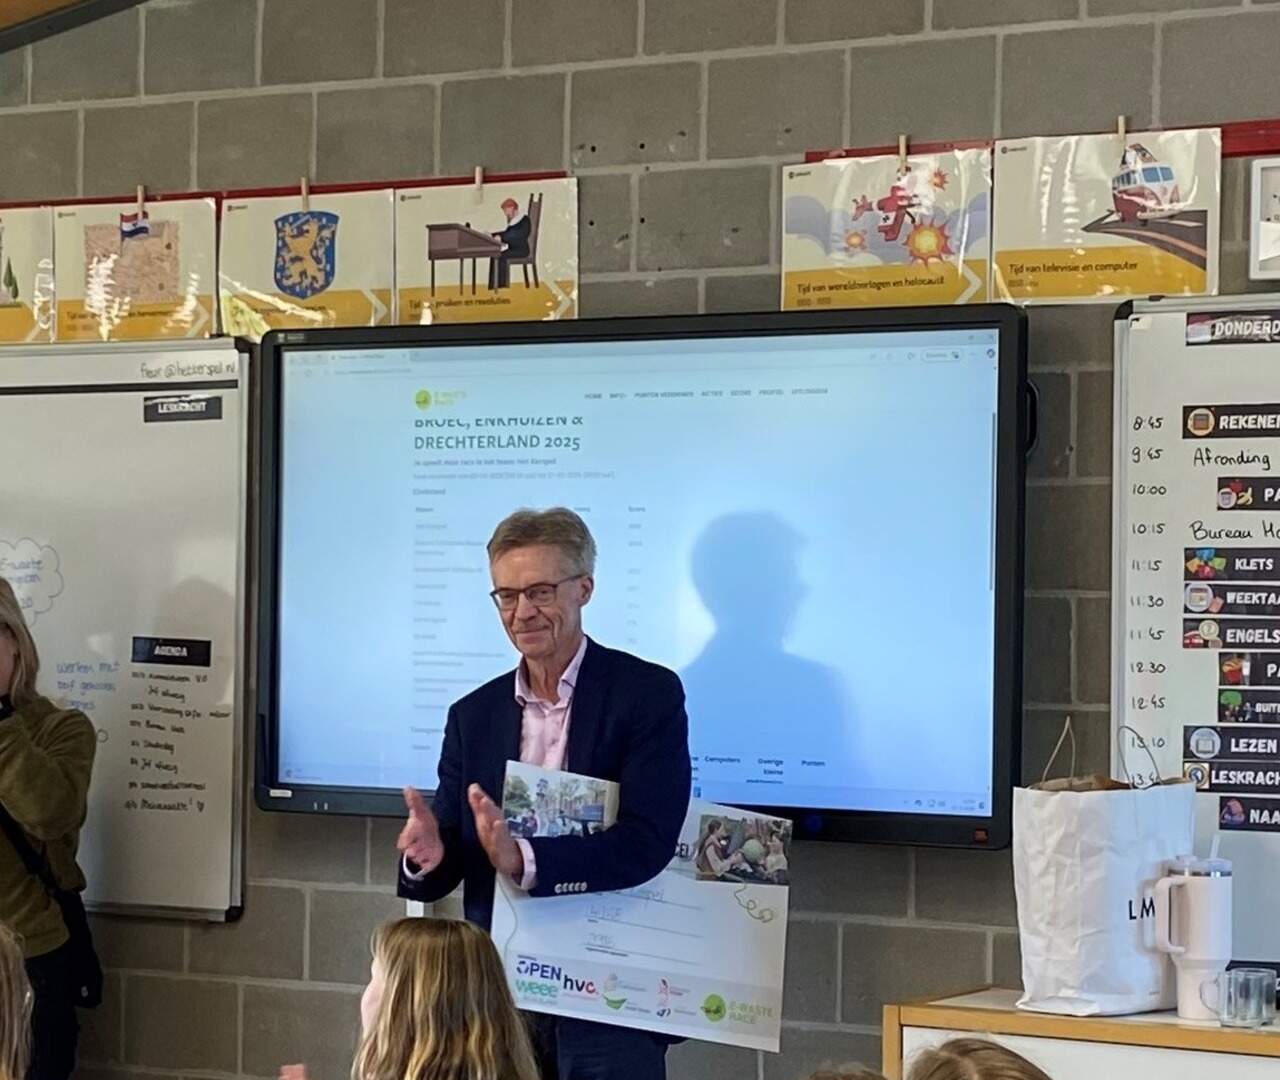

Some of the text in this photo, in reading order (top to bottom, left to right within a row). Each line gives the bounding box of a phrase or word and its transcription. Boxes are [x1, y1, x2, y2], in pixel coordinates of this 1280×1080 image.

[1042, 263, 1080, 272] televisie
[1094, 261, 1138, 273] computer
[414, 434, 581, 451] DRECHTERLAND 2025
[1192, 446, 1272, 472] Afronding
[1188, 519, 1253, 542] Bureau
[1234, 557, 1275, 571] KLETS
[1230, 737, 1279, 754] LEZEN
